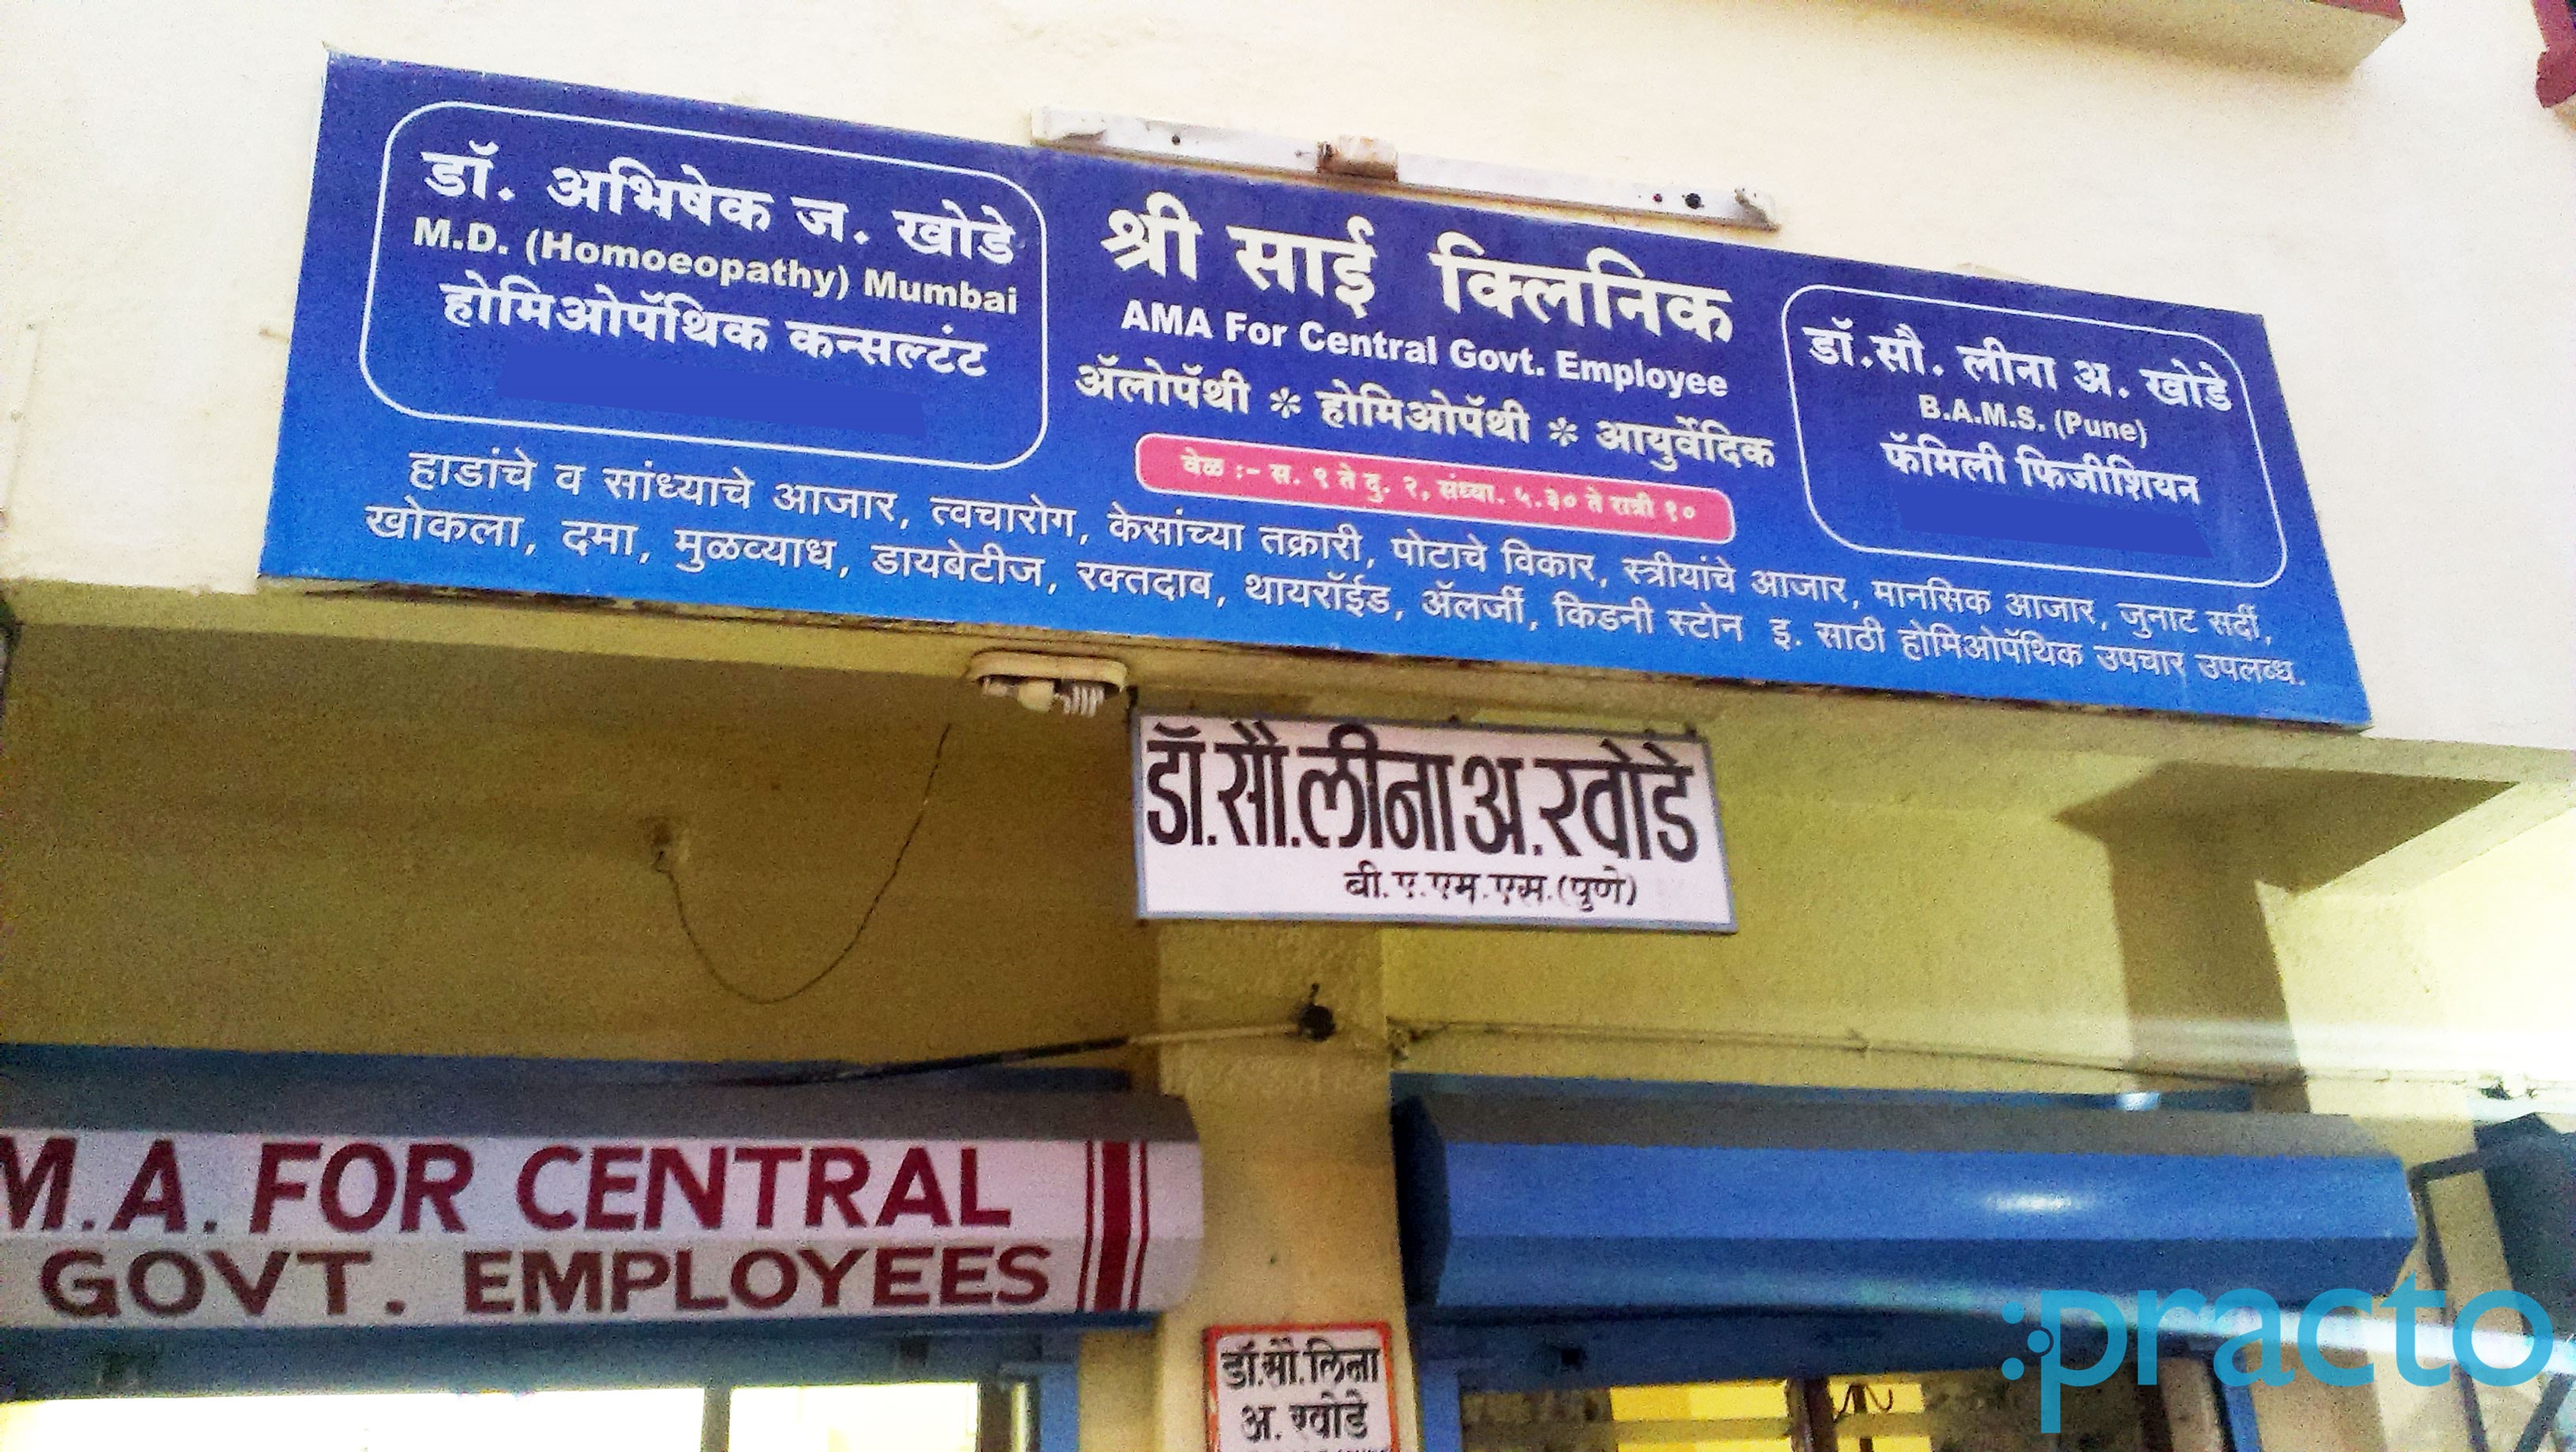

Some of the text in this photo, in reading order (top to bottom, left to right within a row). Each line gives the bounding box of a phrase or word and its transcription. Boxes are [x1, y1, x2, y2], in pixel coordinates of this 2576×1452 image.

[421, 140, 1016, 264] डॉ. अभिषेक ज. खोडे
[414, 217, 1018, 314] M.D. (Homoeopathy) Mumbai
[1101, 191, 1734, 343] श्री साई क्लिनिक
[438, 270, 988, 377] होमिओपॅथिक कन्सल्टंट
[1121, 299, 1729, 399] AMA For Central Govt. Employee
[1919, 395, 2148, 449] B.A.M.S. (Pune)
[1956, 337, 2057, 391] लीना
[2074, 359, 2130, 399] अ.
[2140, 359, 2234, 412] खोडे
[1314, 379, 1530, 443] होमिओपॅथी
[1596, 414, 1775, 472] आयुर्वेदिक
[1880, 432, 2200, 505] फॅमिली फिजीशियन
[366, 496, 535, 555] खोकला,
[561, 520, 650, 565] दमा,
[675, 528, 850, 578] मुळव्याध,
[871, 539, 1056, 595] डायबेटीज,
[1076, 560, 1226, 608] रक्तदाब,
[1245, 572, 1402, 621] थायरॉईड,
[1552, 590, 1653, 634] किडनी
[1667, 602, 1743, 641] स्टोन
[1770, 617, 1800, 651] इ.
[1814, 616, 1885, 652] साठी
[1897, 619, 2084, 667] होमिओपॅथिक
[2093, 645, 2185, 677] उपचार
[410, 447, 537, 492] हाडांचे
[555, 463, 585, 494] व
[603, 461, 754, 509] सांध्याचे
[773, 481, 909, 530] आजार,
[930, 495, 1089, 544] त्वचारोग,
[1107, 502, 1243, 552] केसांच्या
[1260, 522, 1375, 567] तक्रारी,
[1391, 529, 1488, 572] पोटाचे
[1501, 540, 1608, 587] विकार,
[1622, 552, 1735, 593] स्त्रीयांचे
[1750, 569, 1859, 608] आजार,
[1871, 578, 1991, 616] मानसिक
[2005, 593, 2107, 631] आजार,
[2115, 603, 2198, 639] जुनाट
[249, 1142, 475, 1235] FOR
[515, 1144, 1012, 1233] CENTRAL
[38, 1244, 1053, 1319] GOVT. EMPLOYEES
